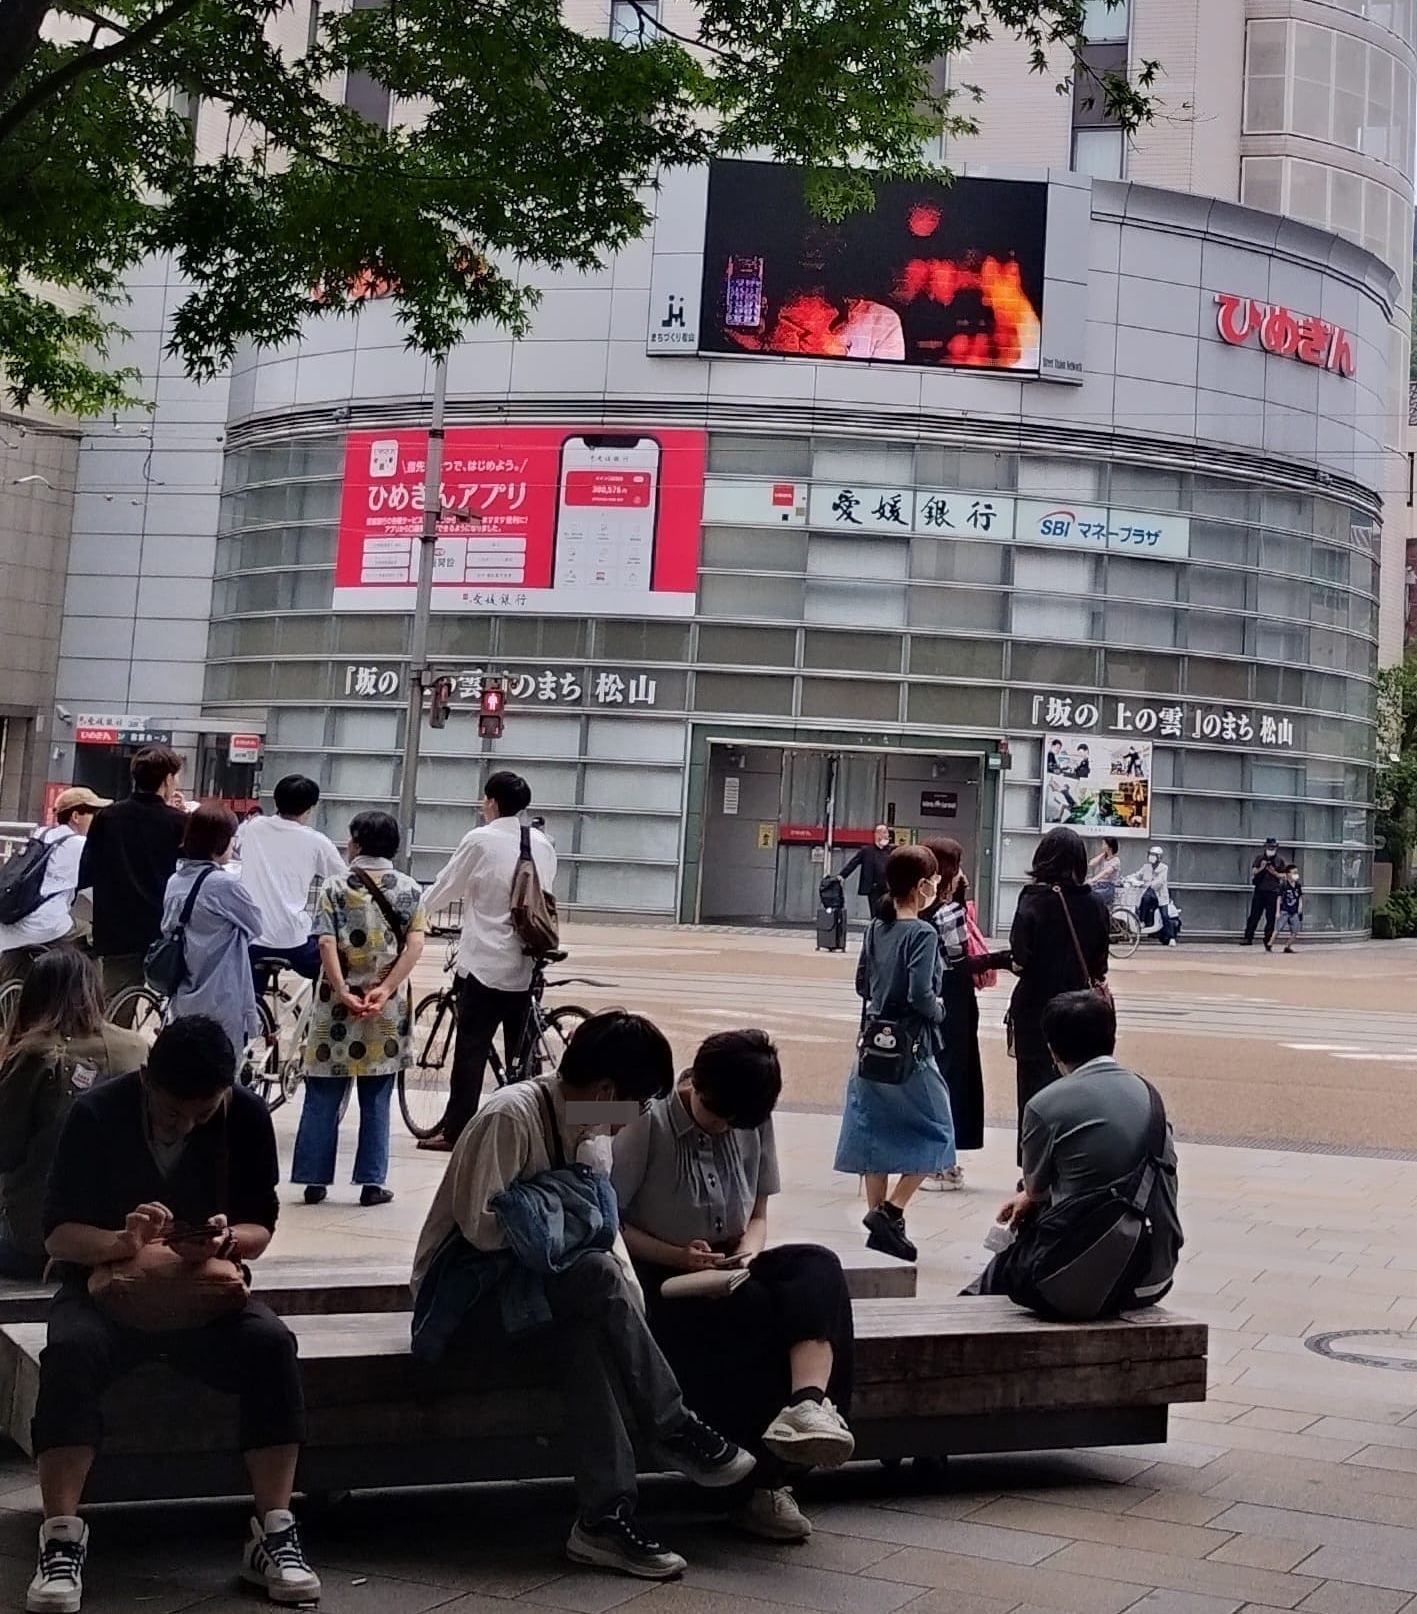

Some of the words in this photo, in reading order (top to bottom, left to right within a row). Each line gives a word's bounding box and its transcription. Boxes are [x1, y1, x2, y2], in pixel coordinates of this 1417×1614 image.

[1214, 293, 1356, 378] ひめぎん
[831, 489, 998, 532] 愛媛銀行
[1040, 518, 1070, 538] SBI
[1077, 521, 1162, 546] マネープラザ
[596, 671, 657, 705] 松山
[1259, 714, 1294, 747] 松山
